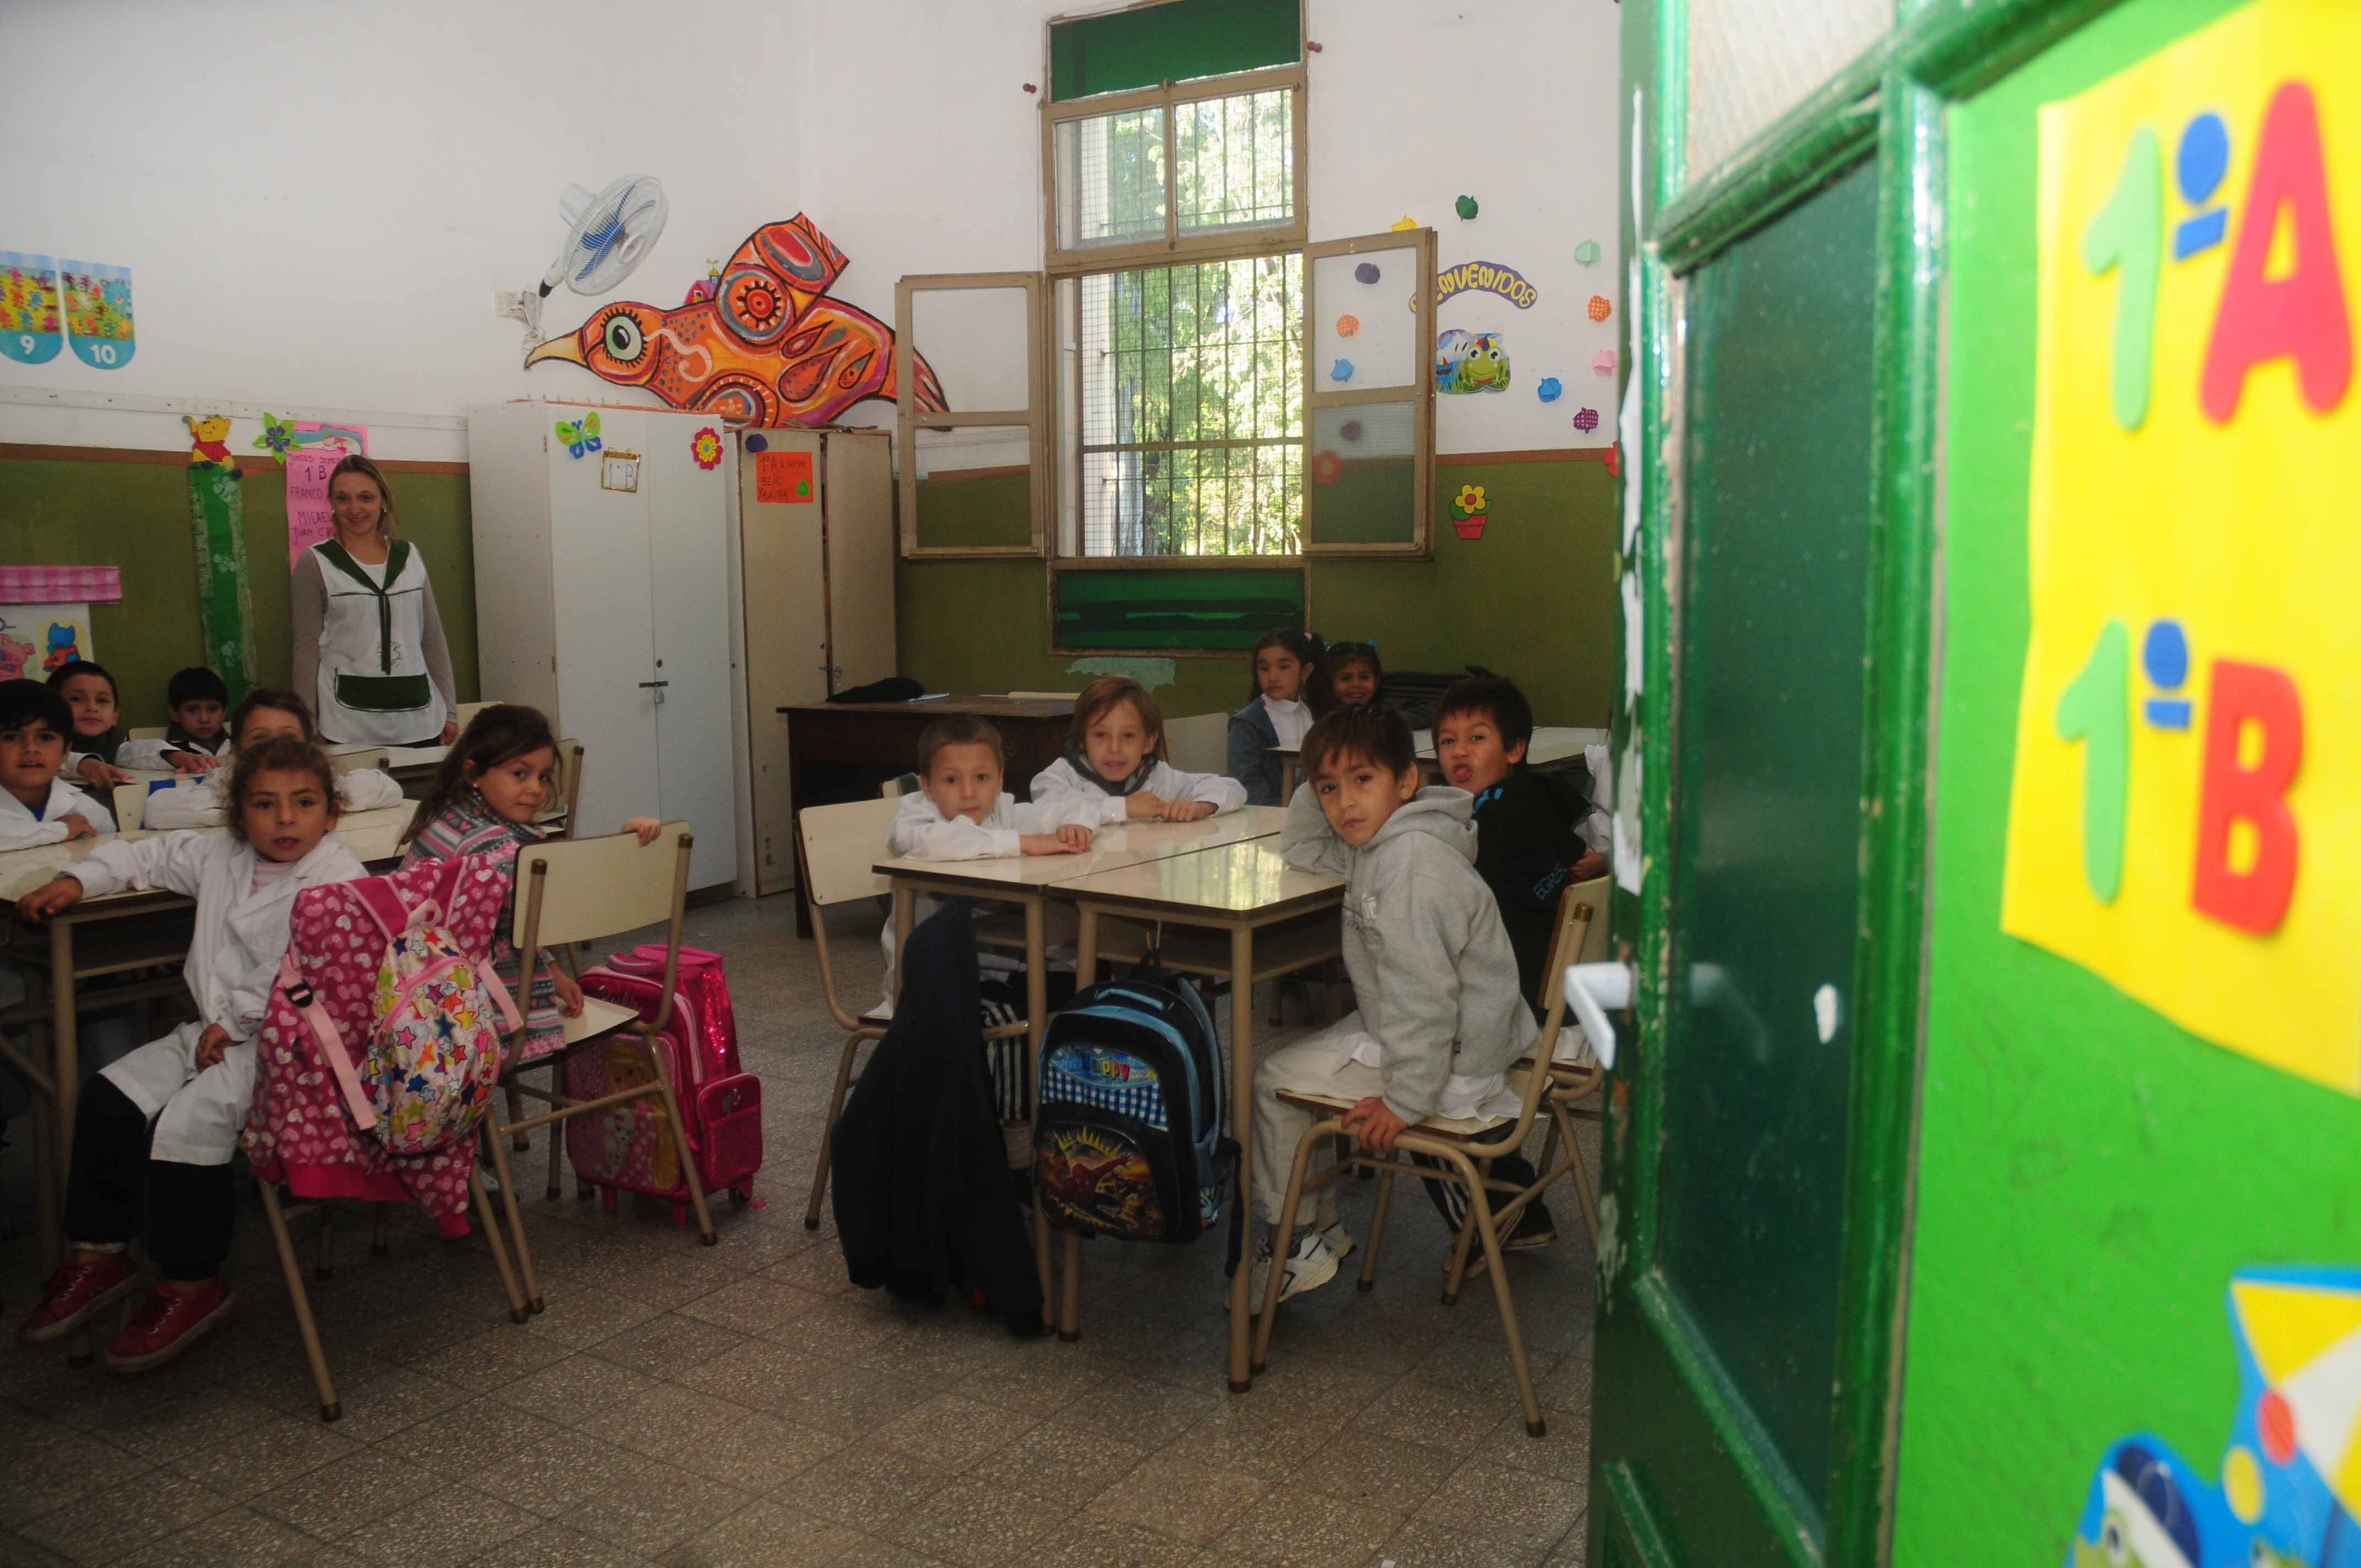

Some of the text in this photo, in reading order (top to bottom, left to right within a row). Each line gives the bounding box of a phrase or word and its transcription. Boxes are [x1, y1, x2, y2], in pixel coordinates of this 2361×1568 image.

[1410, 264, 1537, 311] NVENIDOS
[20, 335, 35, 355] 9
[89, 344, 117, 364] 10
[319, 466, 326, 480] B
[290, 487, 322, 500] FRANCO
[297, 511, 331, 525] MICAEL
